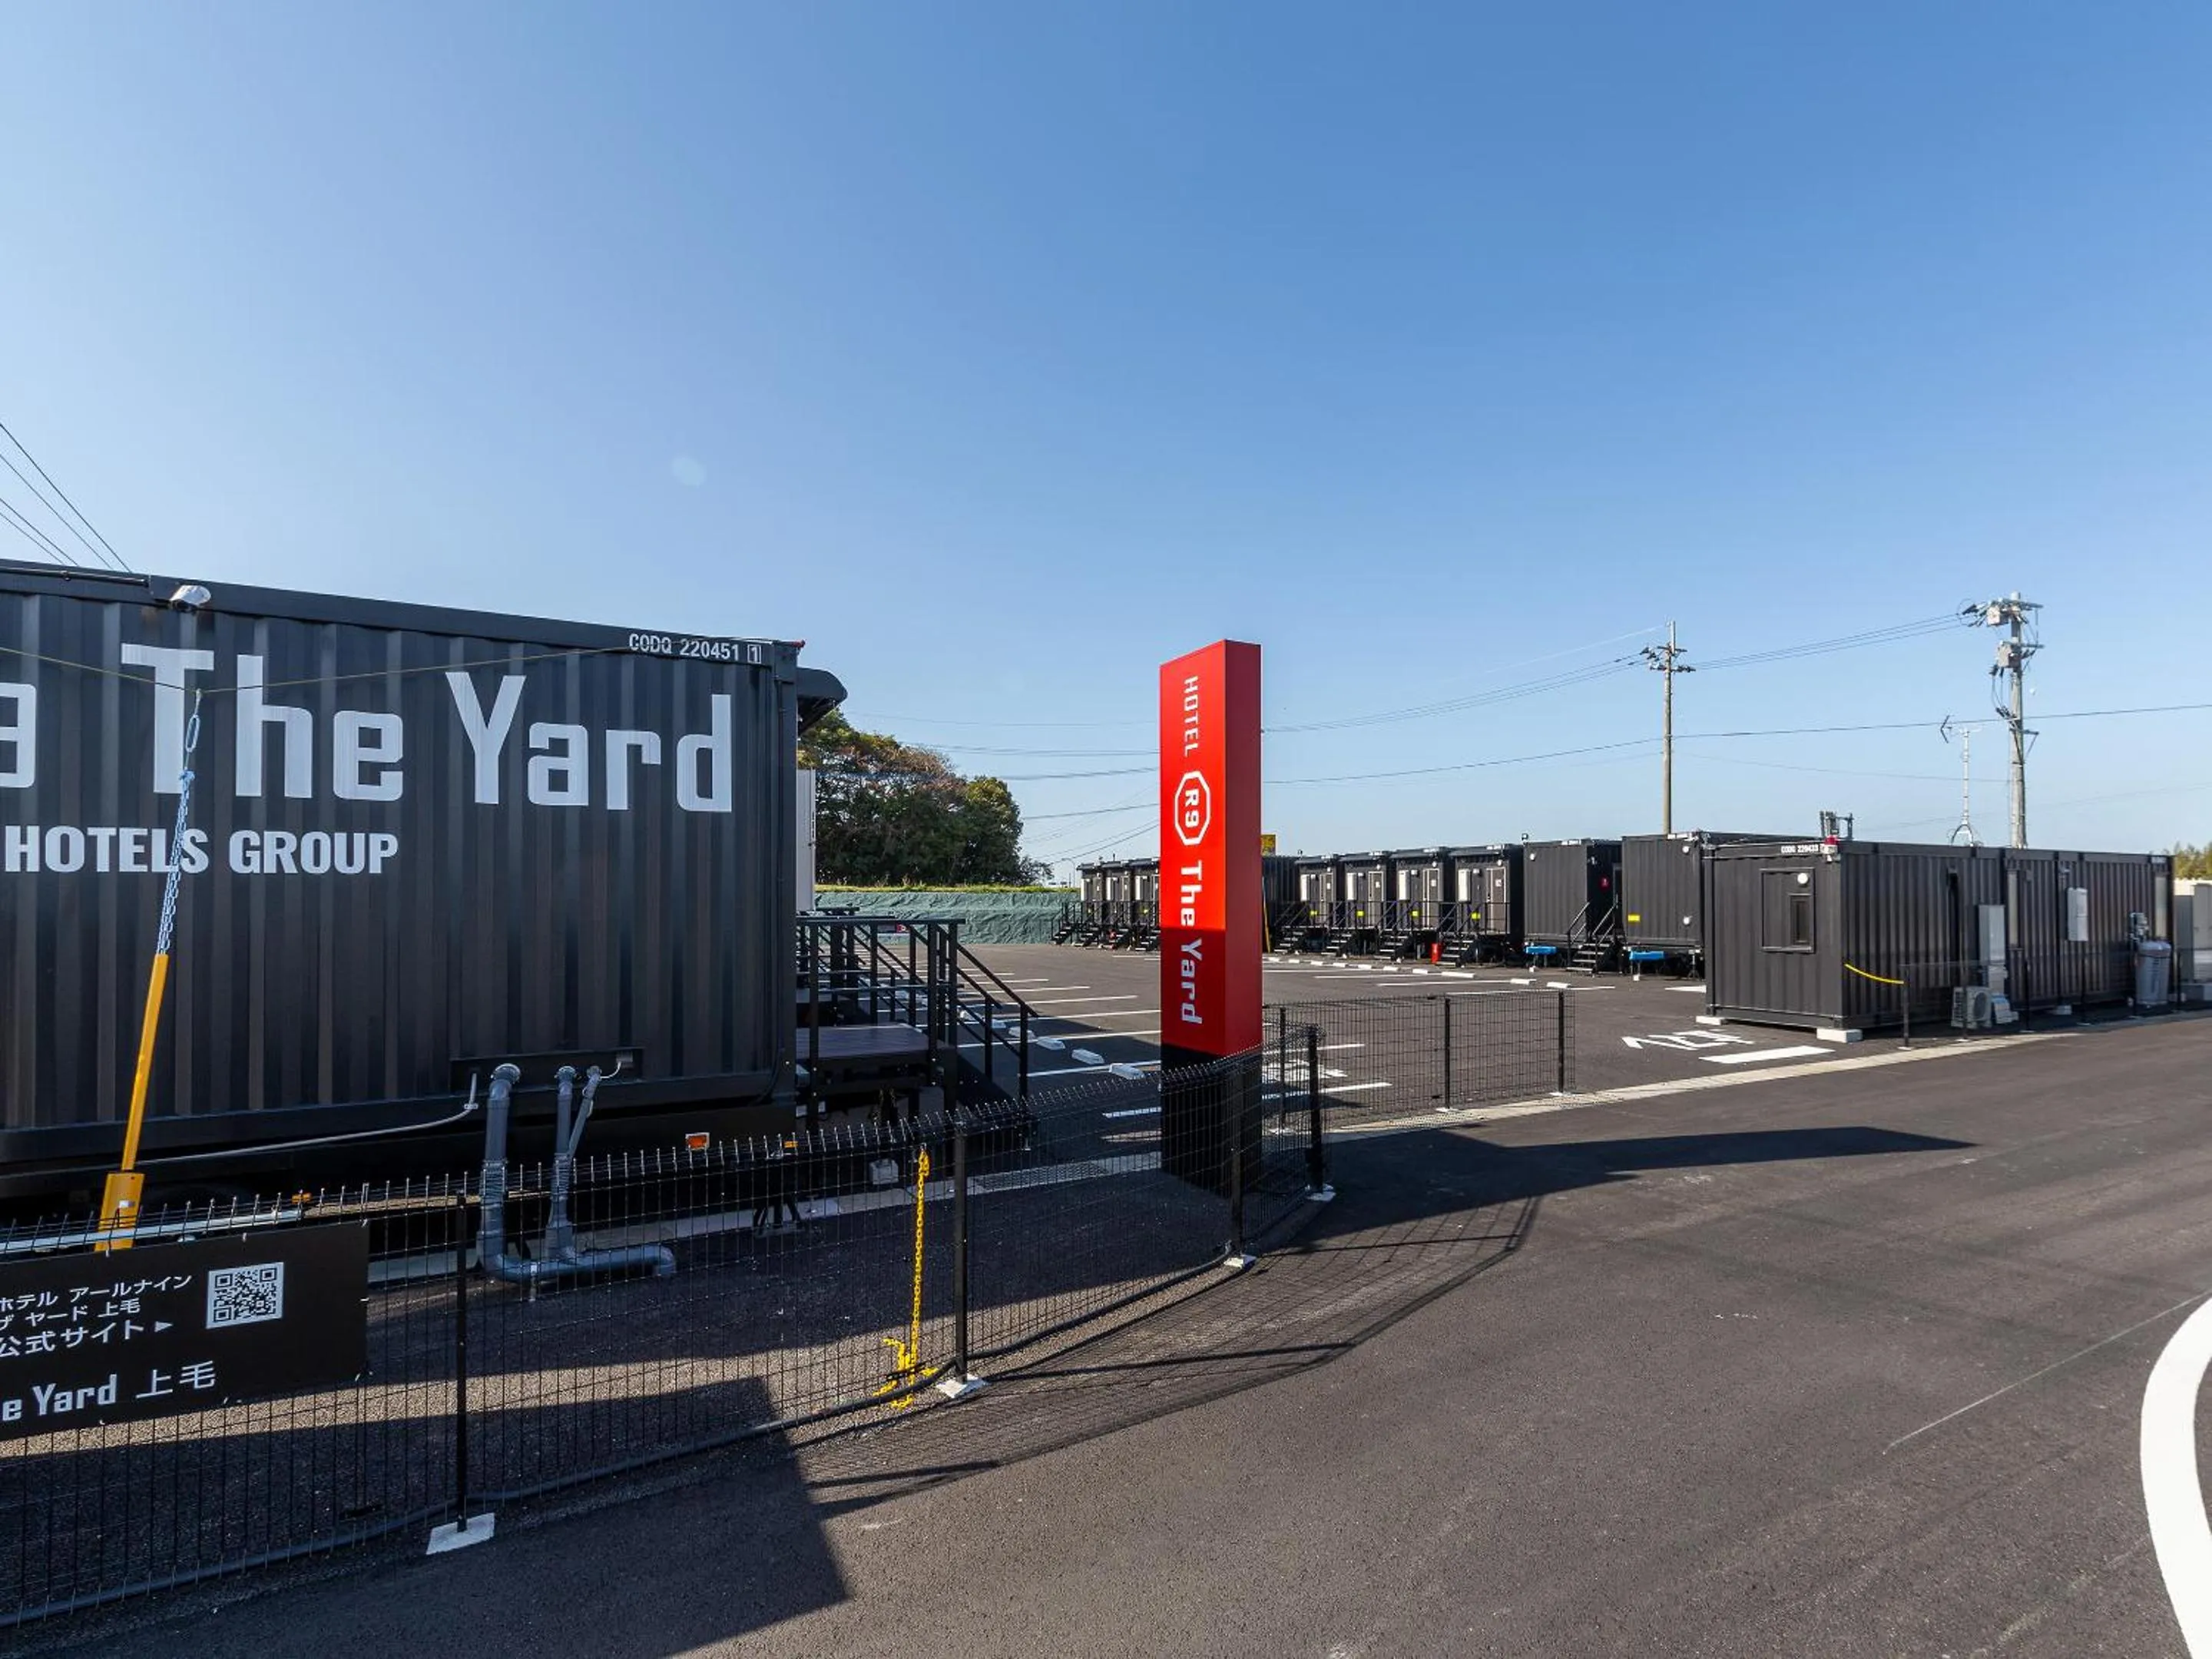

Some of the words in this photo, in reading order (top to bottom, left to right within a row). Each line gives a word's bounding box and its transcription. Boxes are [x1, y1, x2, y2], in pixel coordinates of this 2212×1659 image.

[680, 637, 740, 661] 220451
[121, 642, 403, 802] The
[445, 671, 733, 813] Yard
[1184, 675, 1199, 758] HOTEL
[1185, 789, 1199, 827] R9
[5, 826, 210, 874] HOTELS
[230, 830, 399, 874] GROUP
[1181, 859, 1202, 926] The
[1181, 938, 1202, 1024] Yard
[0, 1291, 58, 1312] ホテル
[69, 1275, 192, 1303] アールナイン
[25, 1305, 88, 1327] ヤード
[98, 1297, 141, 1318] 上毛
[0, 1319, 144, 1358] 公式サイト
[32, 1374, 118, 1416] Yard
[136, 1361, 217, 1399] 上毛
